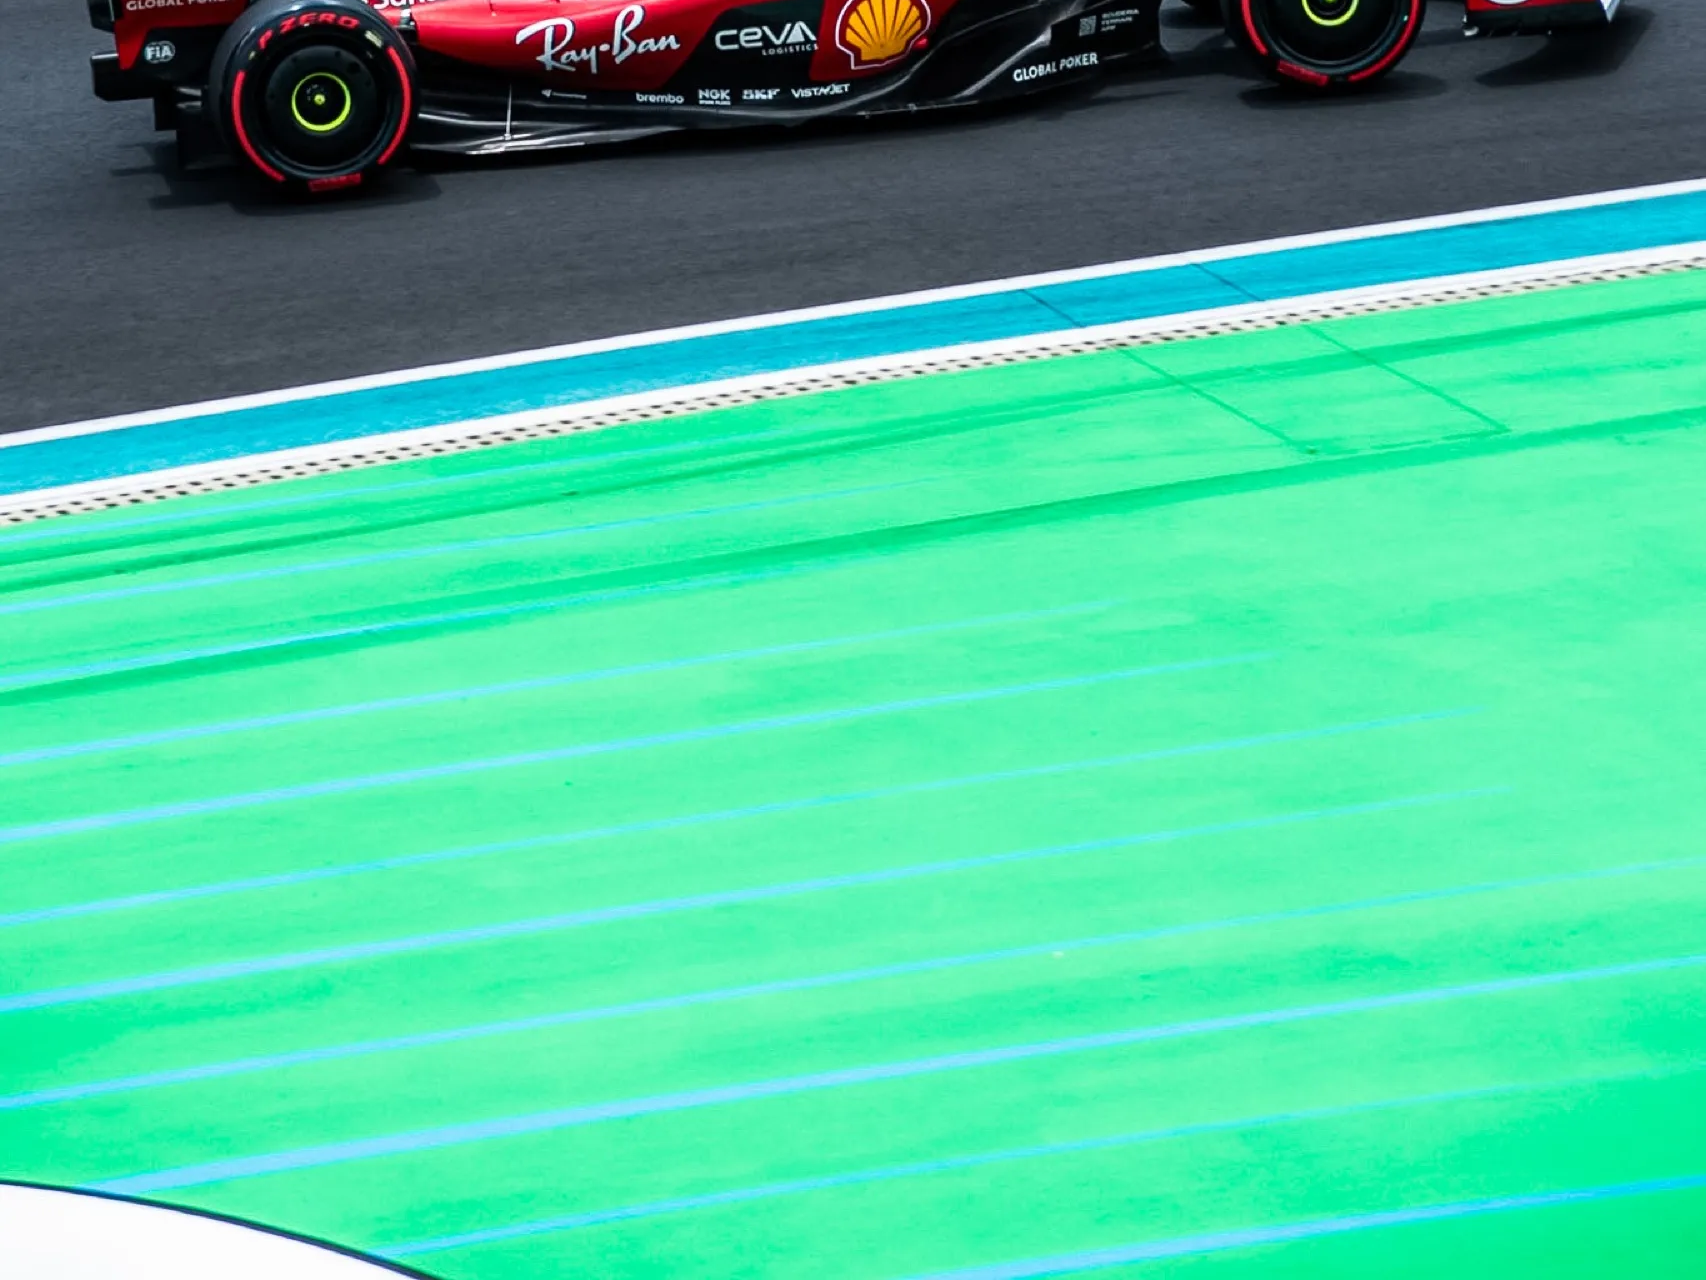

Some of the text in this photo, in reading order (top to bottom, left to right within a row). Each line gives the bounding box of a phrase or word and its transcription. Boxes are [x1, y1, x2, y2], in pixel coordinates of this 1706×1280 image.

[761, 43, 819, 56] LOGISTICS
[1013, 52, 1099, 82] GLOBAL POKER
[636, 92, 685, 104] brembo
[698, 89, 731, 100] NGK
[741, 88, 781, 100] SKF
